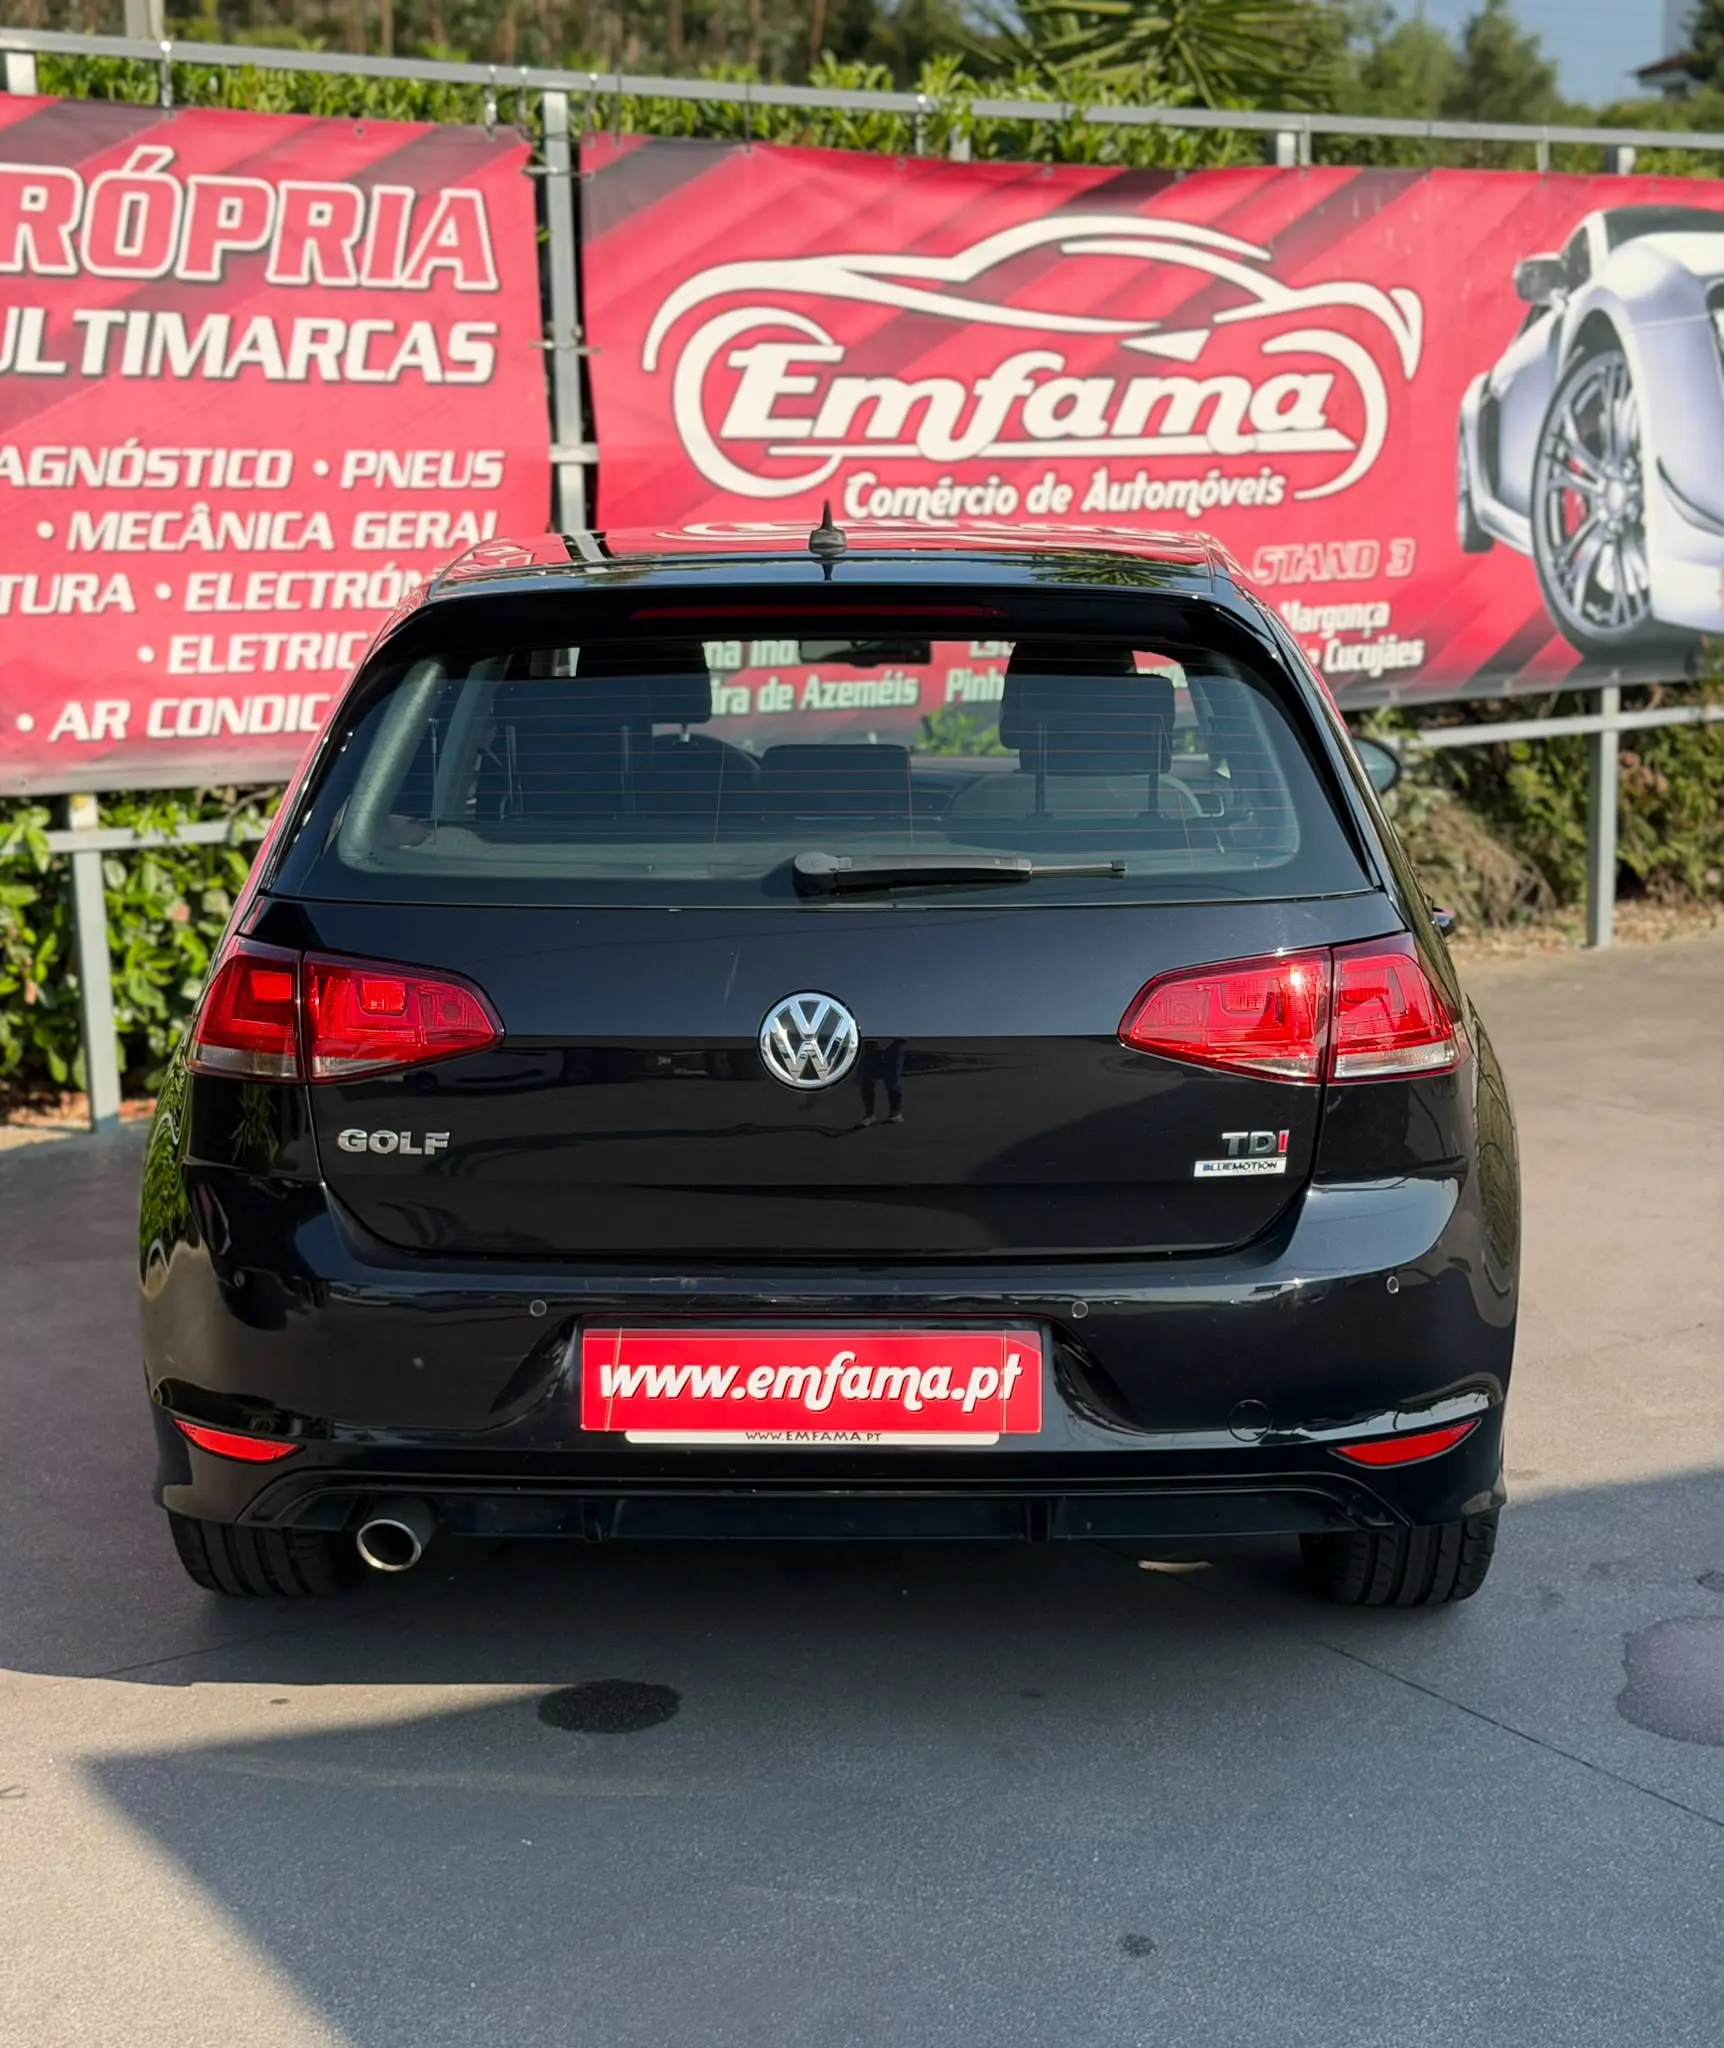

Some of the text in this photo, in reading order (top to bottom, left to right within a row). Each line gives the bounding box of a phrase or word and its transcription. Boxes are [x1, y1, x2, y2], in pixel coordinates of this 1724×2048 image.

[719, 343, 1336, 462] Emfama
[340, 450, 505, 490] PNEUS
[844, 466, 1285, 519] Comércio de Automóveis
[67, 503, 334, 552] MECÂNICA
[1252, 537, 1416, 586] STAND 3
[167, 630, 369, 675] ELETRIC
[1323, 635, 1425, 678] Cucujães
[757, 676, 795, 714] de
[798, 670, 919, 711] Azeméis
[48, 692, 332, 741] AR CONDIC
[337, 1128, 450, 1155] GOLF
[1221, 1129, 1290, 1156] TDI
[1202, 1160, 1278, 1171] BLUEMOTION
[600, 1350, 1022, 1413] www.emfama.pt
[745, 1430, 882, 1442] WWW.EMFAMA.PT
